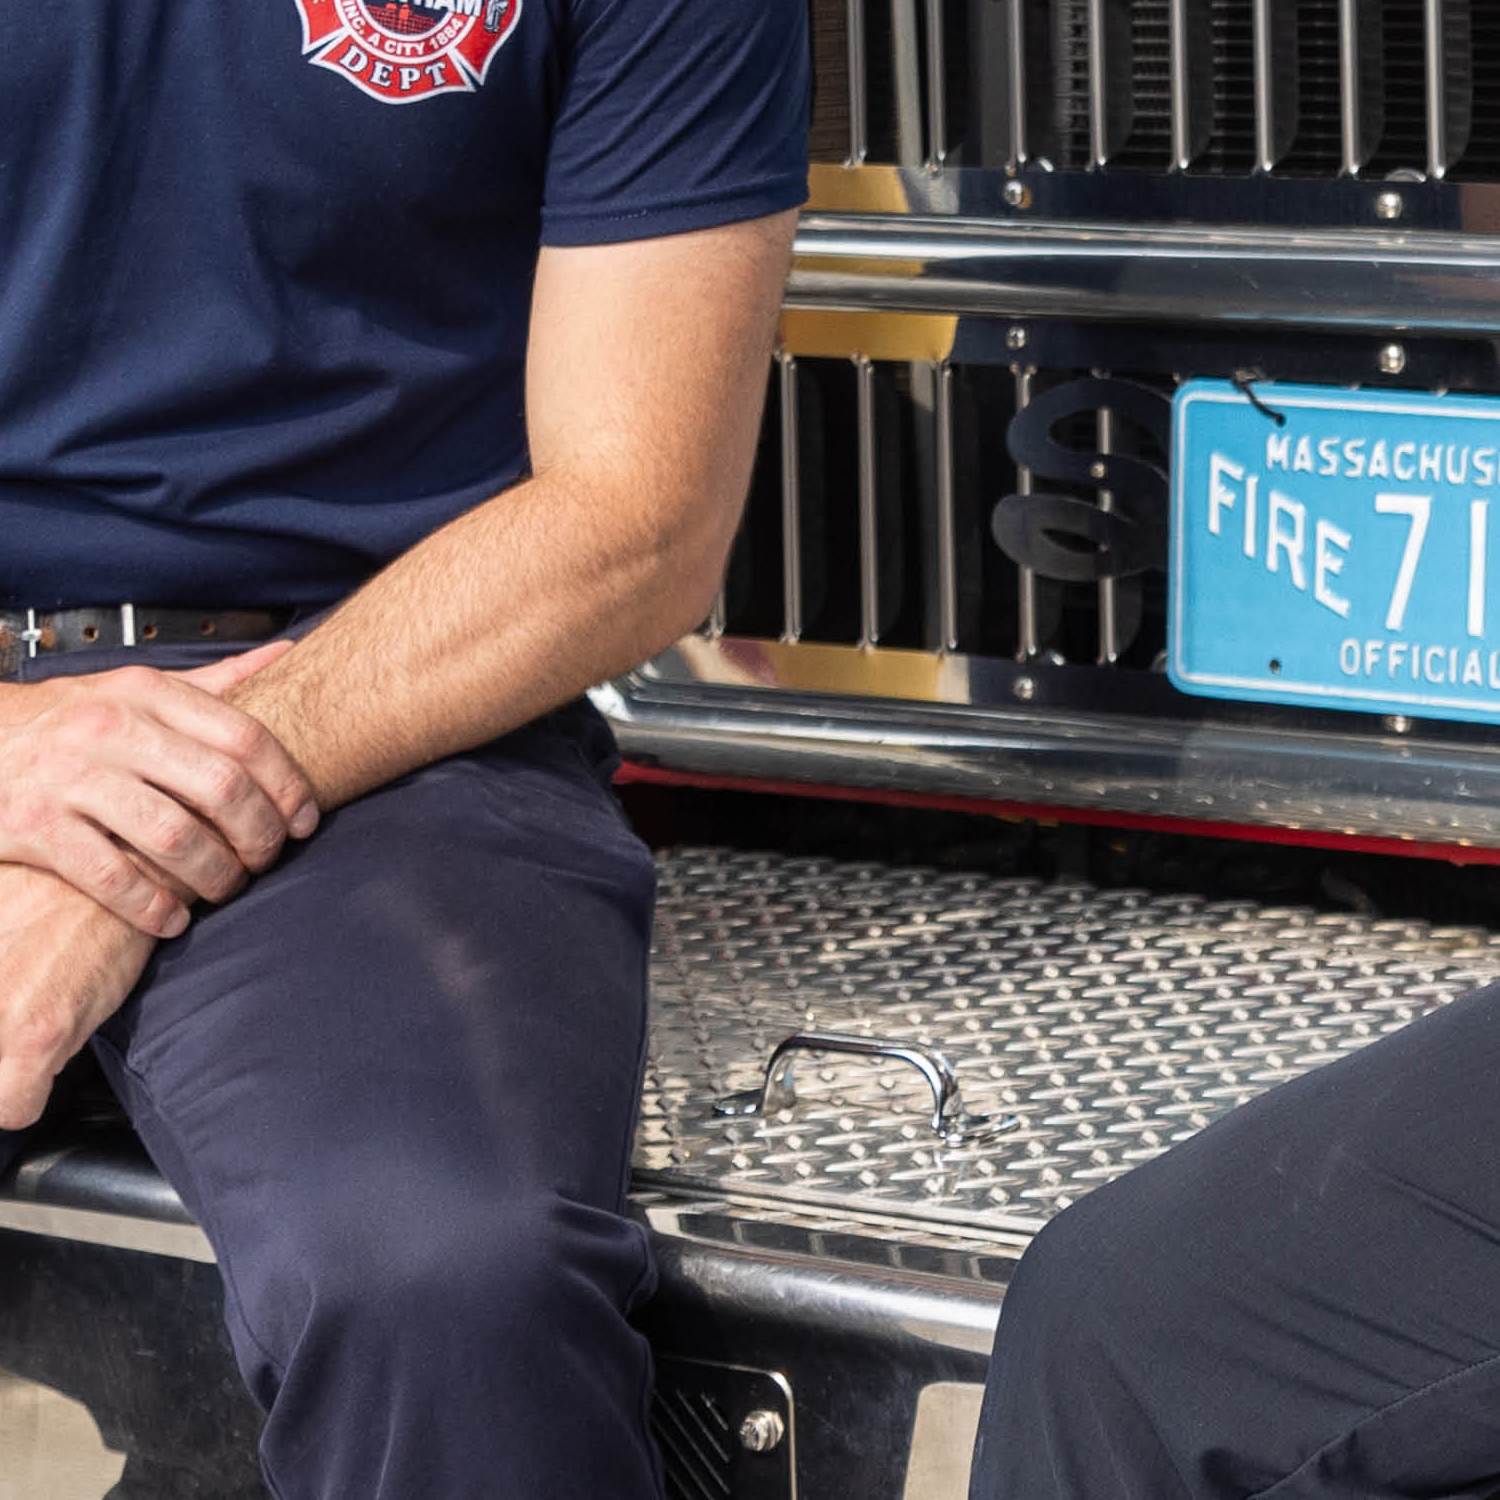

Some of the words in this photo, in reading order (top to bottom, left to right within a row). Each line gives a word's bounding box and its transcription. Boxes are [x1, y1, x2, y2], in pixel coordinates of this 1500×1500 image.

[341, 0, 365, 35] INC.
[367, 35, 381, 47] A
[384, 40, 427, 57] CITY
[429, 17, 465, 50] 1884
[339, 43, 447, 91] DEPT
[1206, 450, 1353, 621] FIRE
